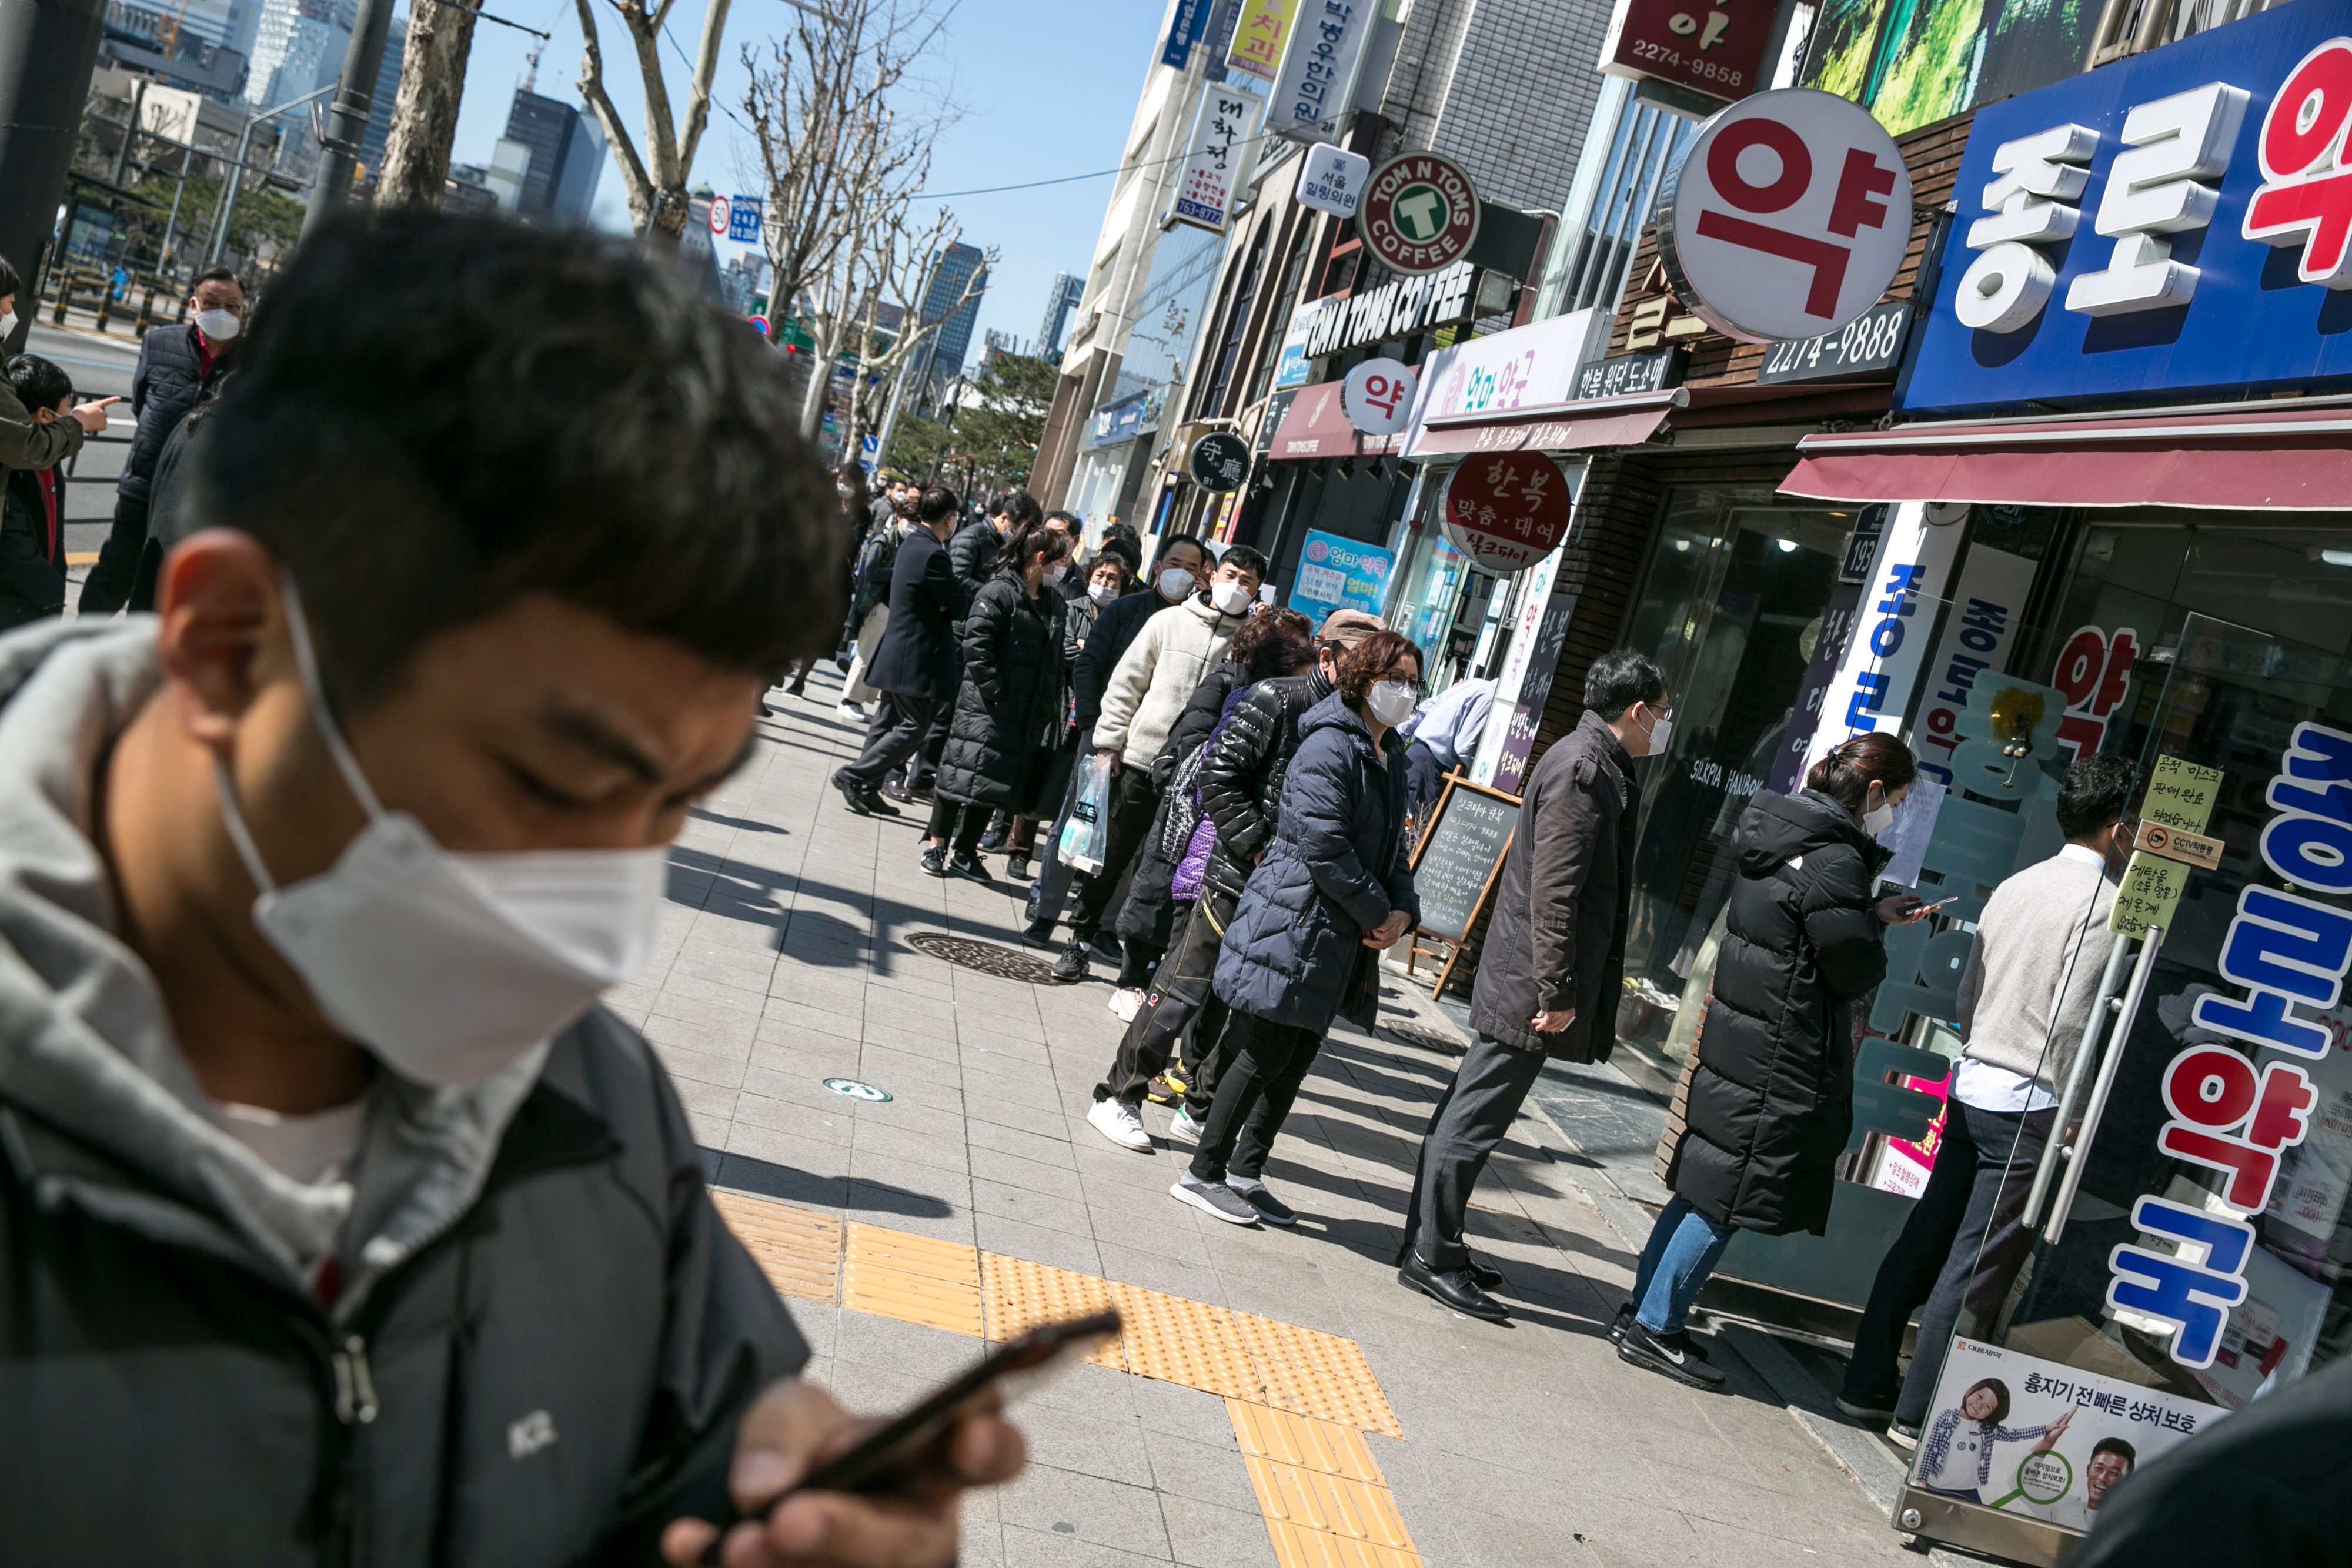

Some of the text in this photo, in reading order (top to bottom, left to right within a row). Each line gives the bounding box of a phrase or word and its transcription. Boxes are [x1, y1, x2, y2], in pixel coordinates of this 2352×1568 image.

[1244, 0, 1284, 62] 치과
[1295, 0, 1352, 123] 박병우한의원
[1632, 39, 1742, 86] 2274-9858
[1206, 99, 1243, 169] 대화정
[1321, 122, 1335, 132] 2F
[1322, 171, 1346, 189] 서울
[1372, 161, 1469, 226] TOM N TOMS
[1305, 182, 1356, 208] 힐링의원
[714, 206, 725, 225] 50
[1178, 200, 1222, 226] 763-8772
[1398, 190, 1438, 239] T
[1696, 117, 1897, 320] 약
[1372, 219, 1459, 265] COFFEE
[1301, 302, 1339, 359] TOM
[1328, 297, 1352, 352] N
[1343, 282, 1398, 348] TOMS
[1578, 355, 1667, 400] 한복 원단 도소매
[1365, 375, 1405, 420] 약
[1203, 477, 1213, 486] B1
[1486, 459, 1549, 513] 한복
[1466, 532, 1529, 564] 실크피아
[1850, 540, 1875, 572] 193
[1323, 569, 1342, 580] 마스크
[1347, 578, 1378, 599] 엄마!
[1540, 608, 1569, 658] 한복
[1500, 750, 1526, 778] 실크피아
[1690, 759, 1722, 787] SILKPIA
[2159, 757, 2218, 783] 공적 마스크
[2153, 783, 2204, 805] 판매 완료
[1456, 798, 1504, 824] 실크피아 한복
[1441, 829, 1458, 842] 선물용
[2174, 837, 2213, 855] CCTV작동중
[1421, 865, 1440, 879] 당신의
[2130, 864, 2167, 884] 에탄올
[2132, 880, 2151, 893] (소독
[2119, 894, 2159, 915] 체온계
[2117, 917, 2149, 934] 없습니
[2106, 721, 2352, 1370] 종로약국
[1968, 1343, 2002, 1359] 대웅제약
[2025, 1373, 2197, 1436] 흉지기 전 빠른 상처 보호
